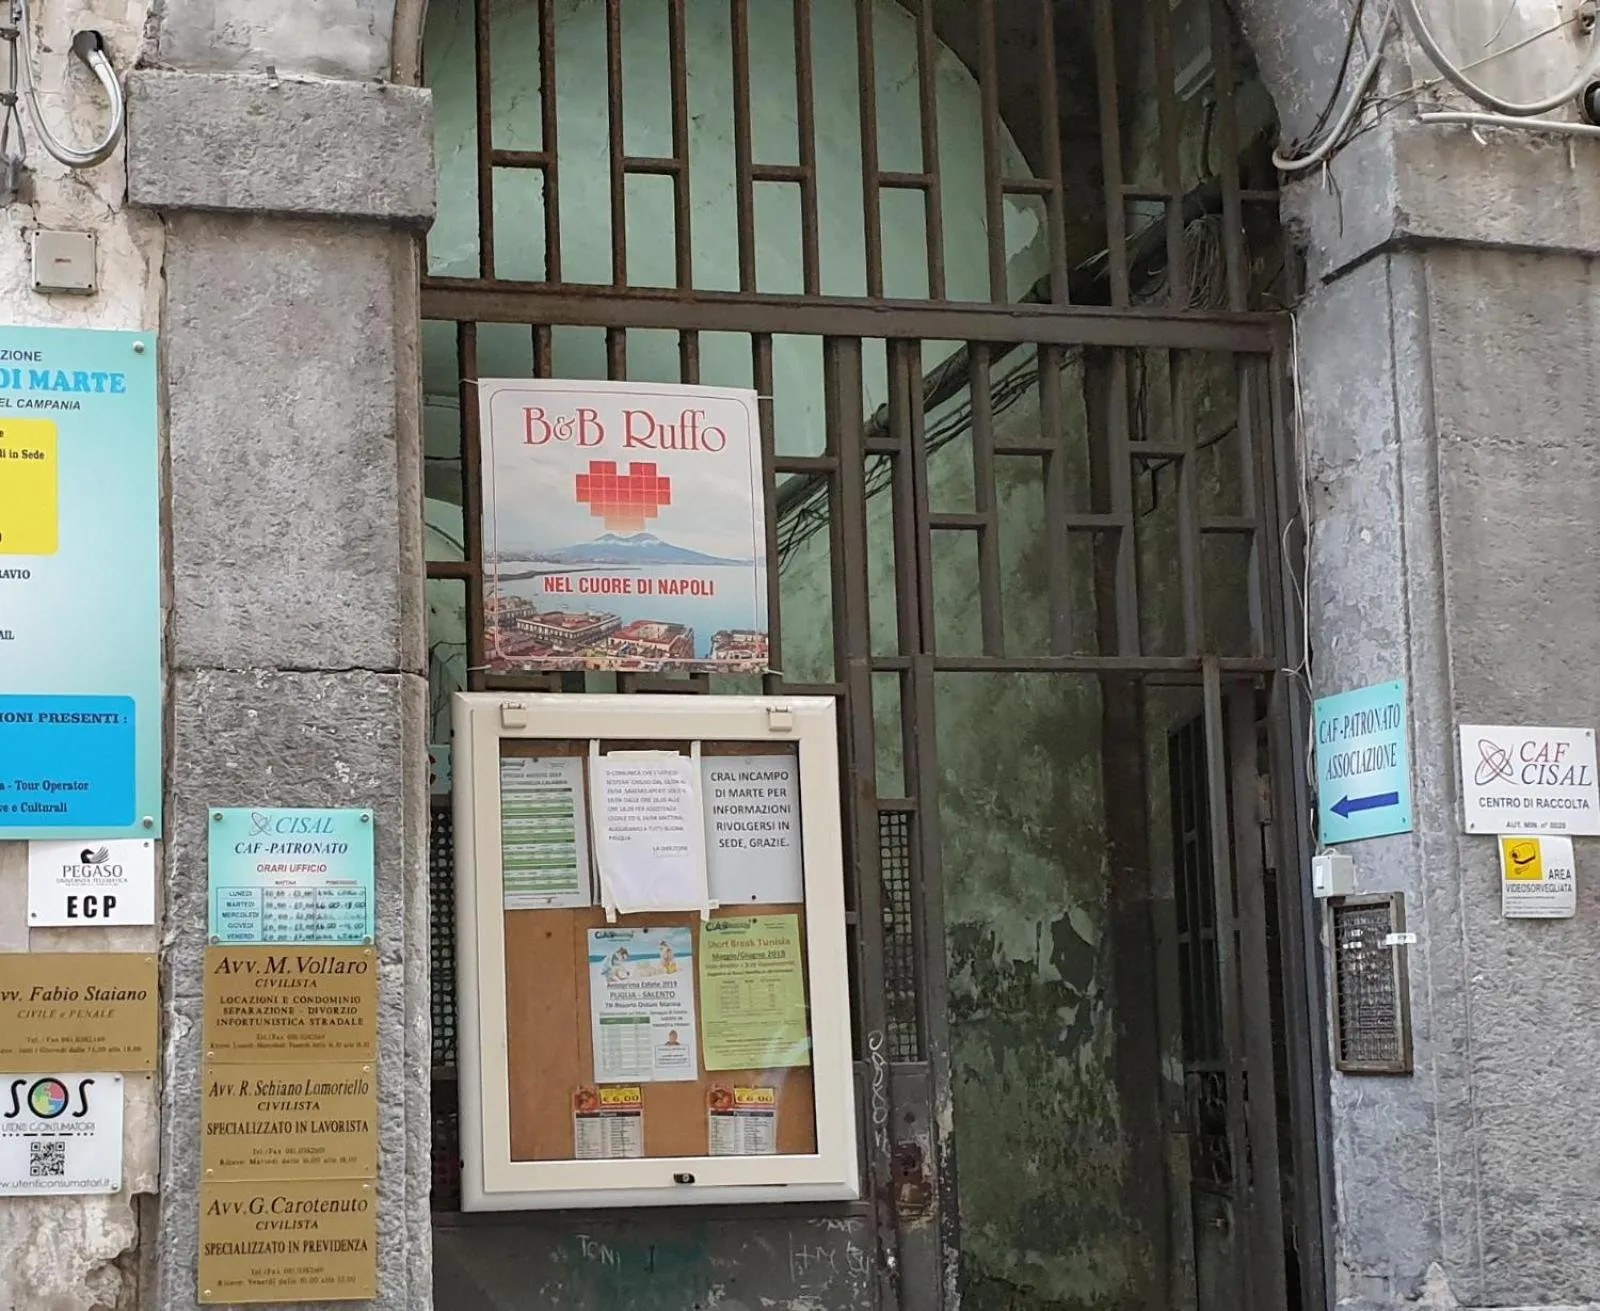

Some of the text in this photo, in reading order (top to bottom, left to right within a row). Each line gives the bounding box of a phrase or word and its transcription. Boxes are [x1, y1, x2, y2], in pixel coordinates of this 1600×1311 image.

[0, 367, 127, 394] DI MARTE
[16, 398, 81, 410] CAMPANIA
[523, 406, 727, 452] B&B Ruffo
[9, 449, 19, 459] in
[21, 449, 45, 460] Sede
[544, 576, 714, 596] NEL CUORE DI NAPOLI
[38, 712, 119, 724] PRESENTI
[1520, 740, 1570, 763] CAF
[1326, 742, 1397, 781] ASSOCIAZIONE
[710, 771, 789, 782] CRAL INCAMPO
[1521, 764, 1593, 786] CISAL
[15, 780, 40, 791] Tour
[42, 780, 89, 794] Operator
[715, 788, 787, 798] DI MARTE PER
[12, 805, 18, 813] e
[20, 801, 68, 813] Culturali
[1478, 797, 1590, 809] CENTRO DI RACCOLTA
[713, 804, 791, 815] INFORMAZIONI
[275, 816, 335, 834] CISAL
[716, 821, 790, 831] RIVOLGERSI IN
[719, 837, 790, 849] SEDE, GRAZIE.
[62, 864, 123, 878] PEGASO
[256, 864, 327, 873] ORARI UFFICIO
[1547, 869, 1572, 880] AREA
[1506, 883, 1573, 893] VIDEOSORVEGLIATA
[67, 894, 117, 918] ECP
[214, 956, 368, 975] Avv. M. Vollaro
[255, 978, 317, 988] CIVILISTA
[30, 986, 79, 1002] Fabio
[84, 985, 147, 1002] Staiano
[220, 995, 361, 1005] LOCAZIONI E CONDOMINIO
[17, 1009, 57, 1019] CIVILE
[69, 1009, 116, 1019] PENALE
[223, 1006, 295, 1015] SEPARAZIONE
[307, 1007, 358, 1016] DIVORZIO
[216, 1017, 365, 1027] INFORTUNISTICA STRADALE
[209, 1078, 369, 1098] Avv. R. Schiano Lomoriello
[3, 1077, 96, 1119] SOS
[257, 1101, 320, 1111] CIVILISTA
[29, 1121, 96, 1132] CONSUMATORI
[207, 1119, 369, 1136] SPECIALIZZATO IN LAVORISTA
[207, 1195, 368, 1216] Avv. G. Carotenuto
[255, 1220, 319, 1231] CIVILISTA
[204, 1238, 368, 1256] SPECIALIZZATO IN PREVIDENZA
